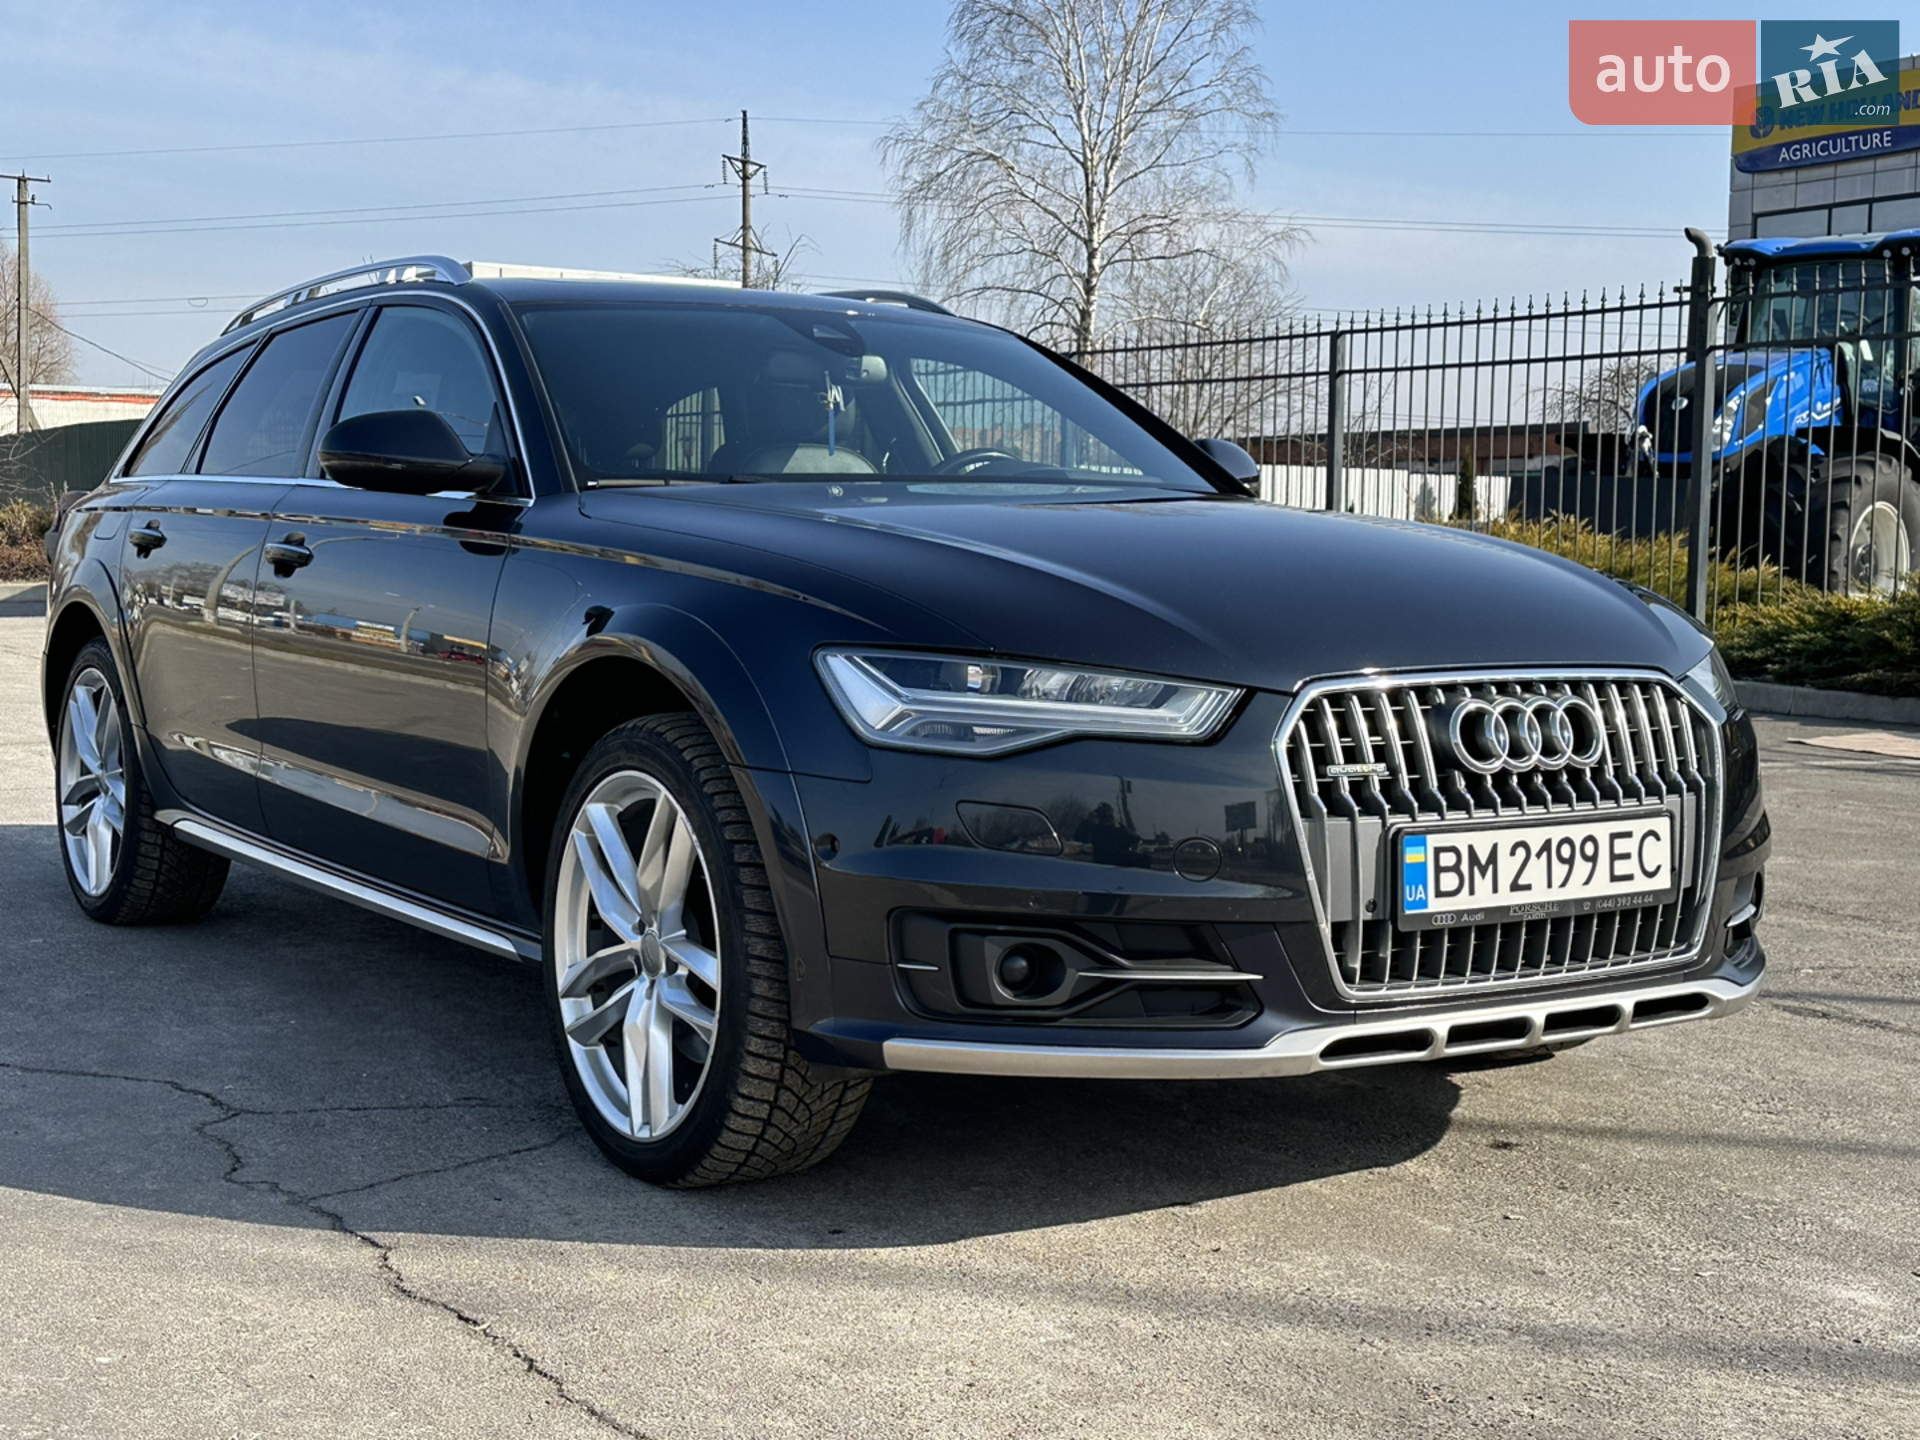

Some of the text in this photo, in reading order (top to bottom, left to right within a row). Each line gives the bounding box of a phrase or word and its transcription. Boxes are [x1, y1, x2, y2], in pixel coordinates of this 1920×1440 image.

[1779, 104, 1825, 130] NEW
[1779, 131, 1892, 162] AGRICULTURE
[1433, 829, 1662, 899] BM 2199 EC
[1406, 884, 1426, 901] UA
[1461, 912, 1485, 922] Audi
